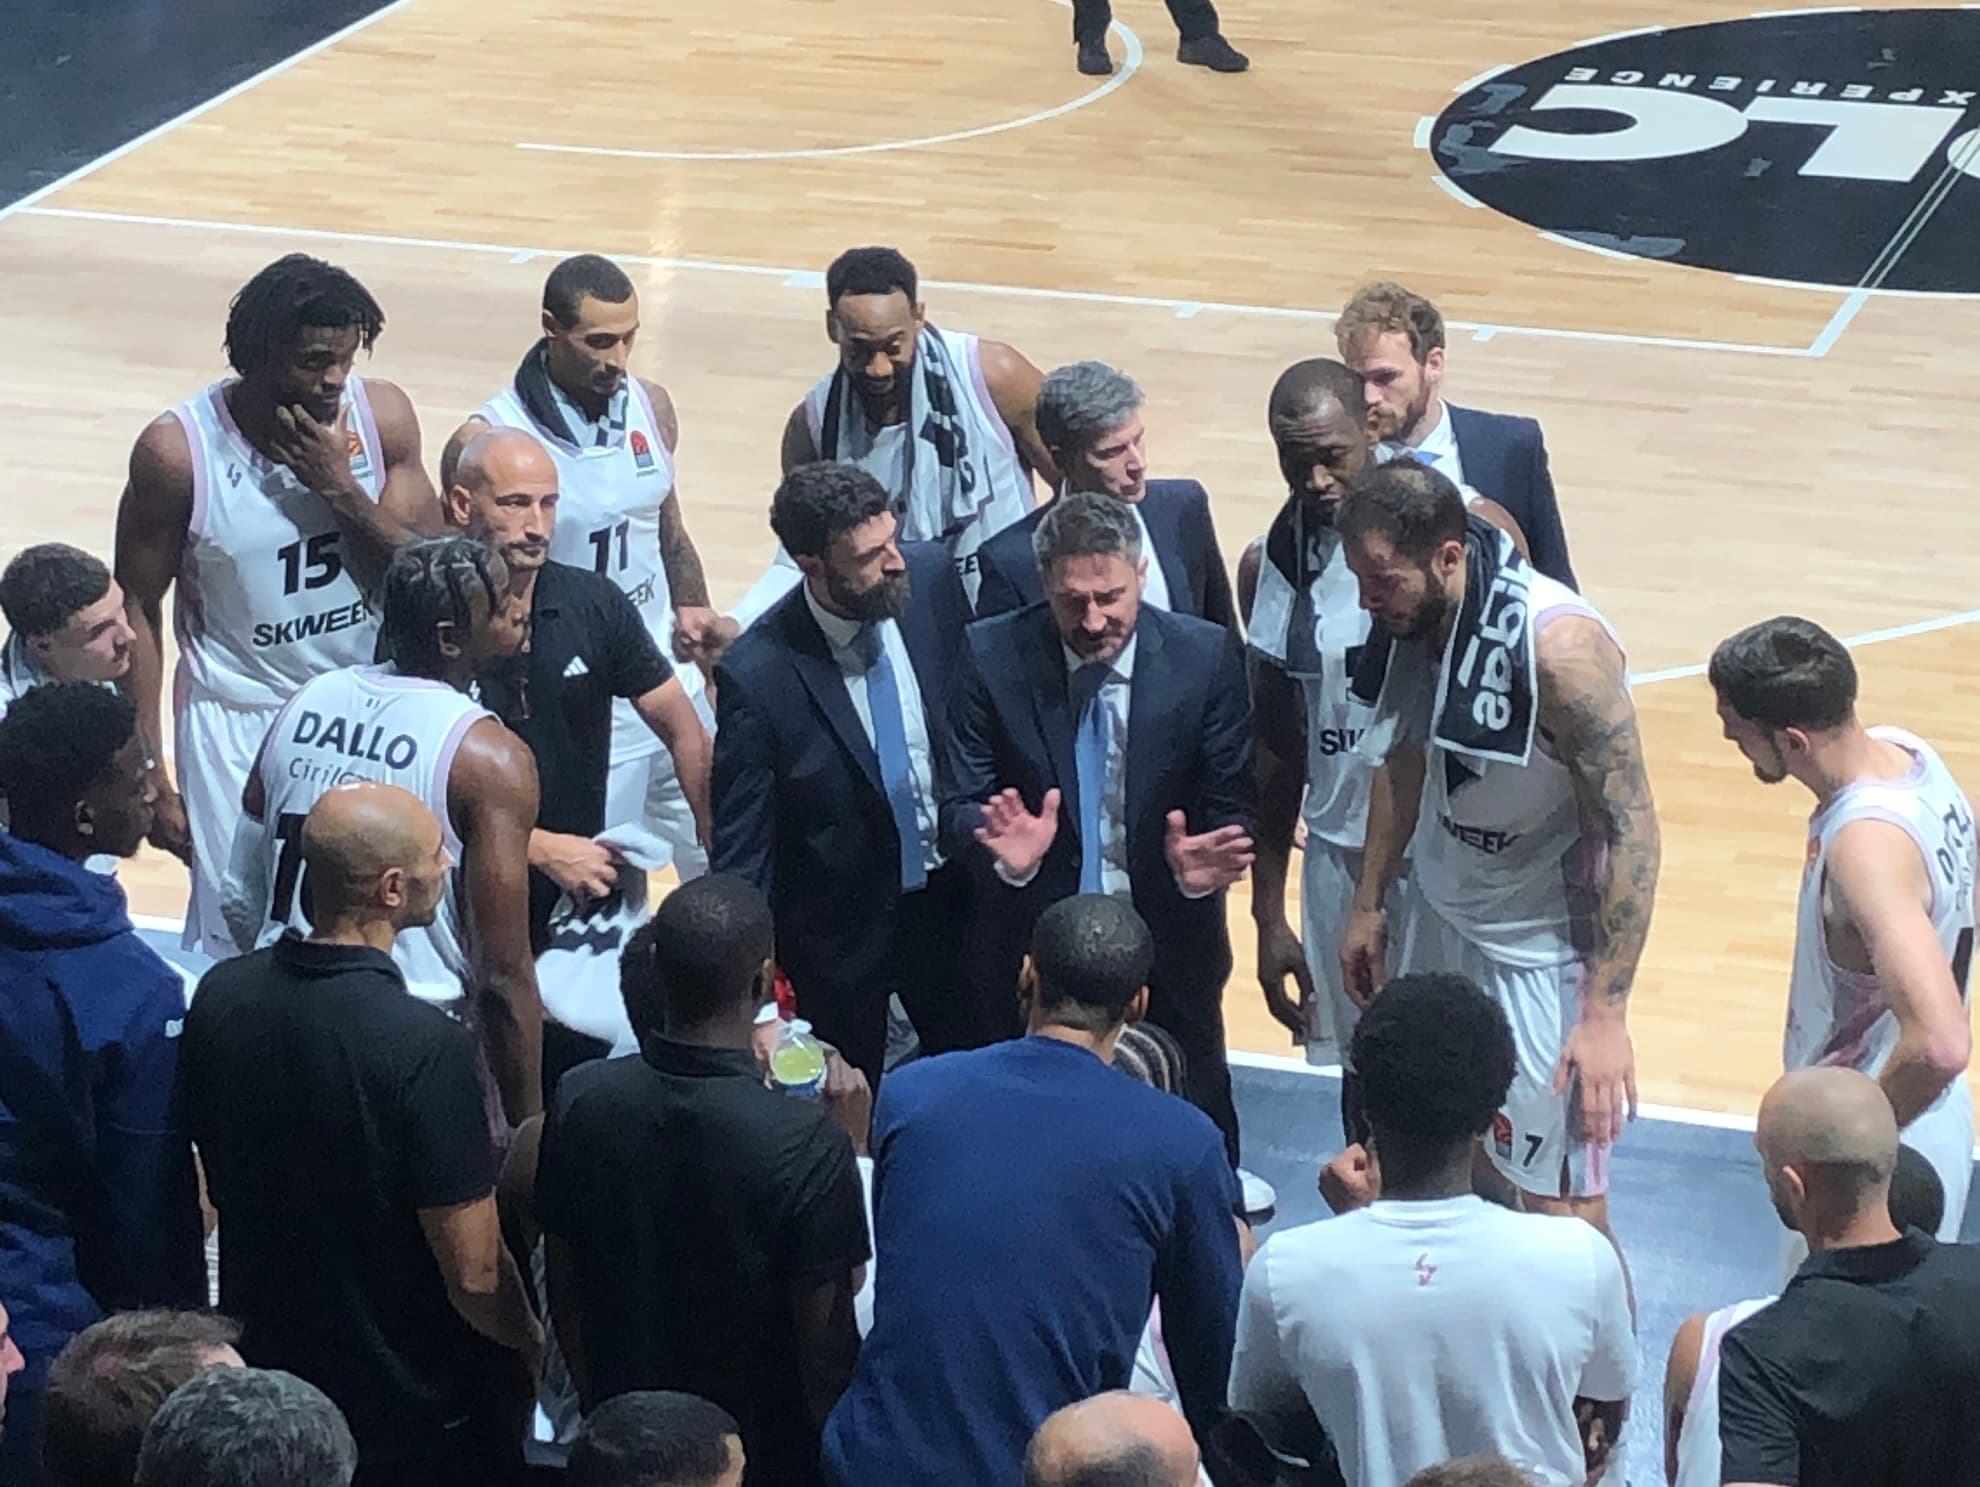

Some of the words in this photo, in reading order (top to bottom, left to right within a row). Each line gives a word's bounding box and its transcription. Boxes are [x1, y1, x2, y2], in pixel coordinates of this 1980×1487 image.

[1564, 66, 1977, 106] XPERIENCE
[1487, 83, 1980, 183] LC
[277, 531, 342, 596] 15
[589, 518, 629, 578] 11
[292, 710, 418, 770] DALLO
[289, 757, 374, 787] Ciril
[1524, 1132, 1544, 1168] 7
